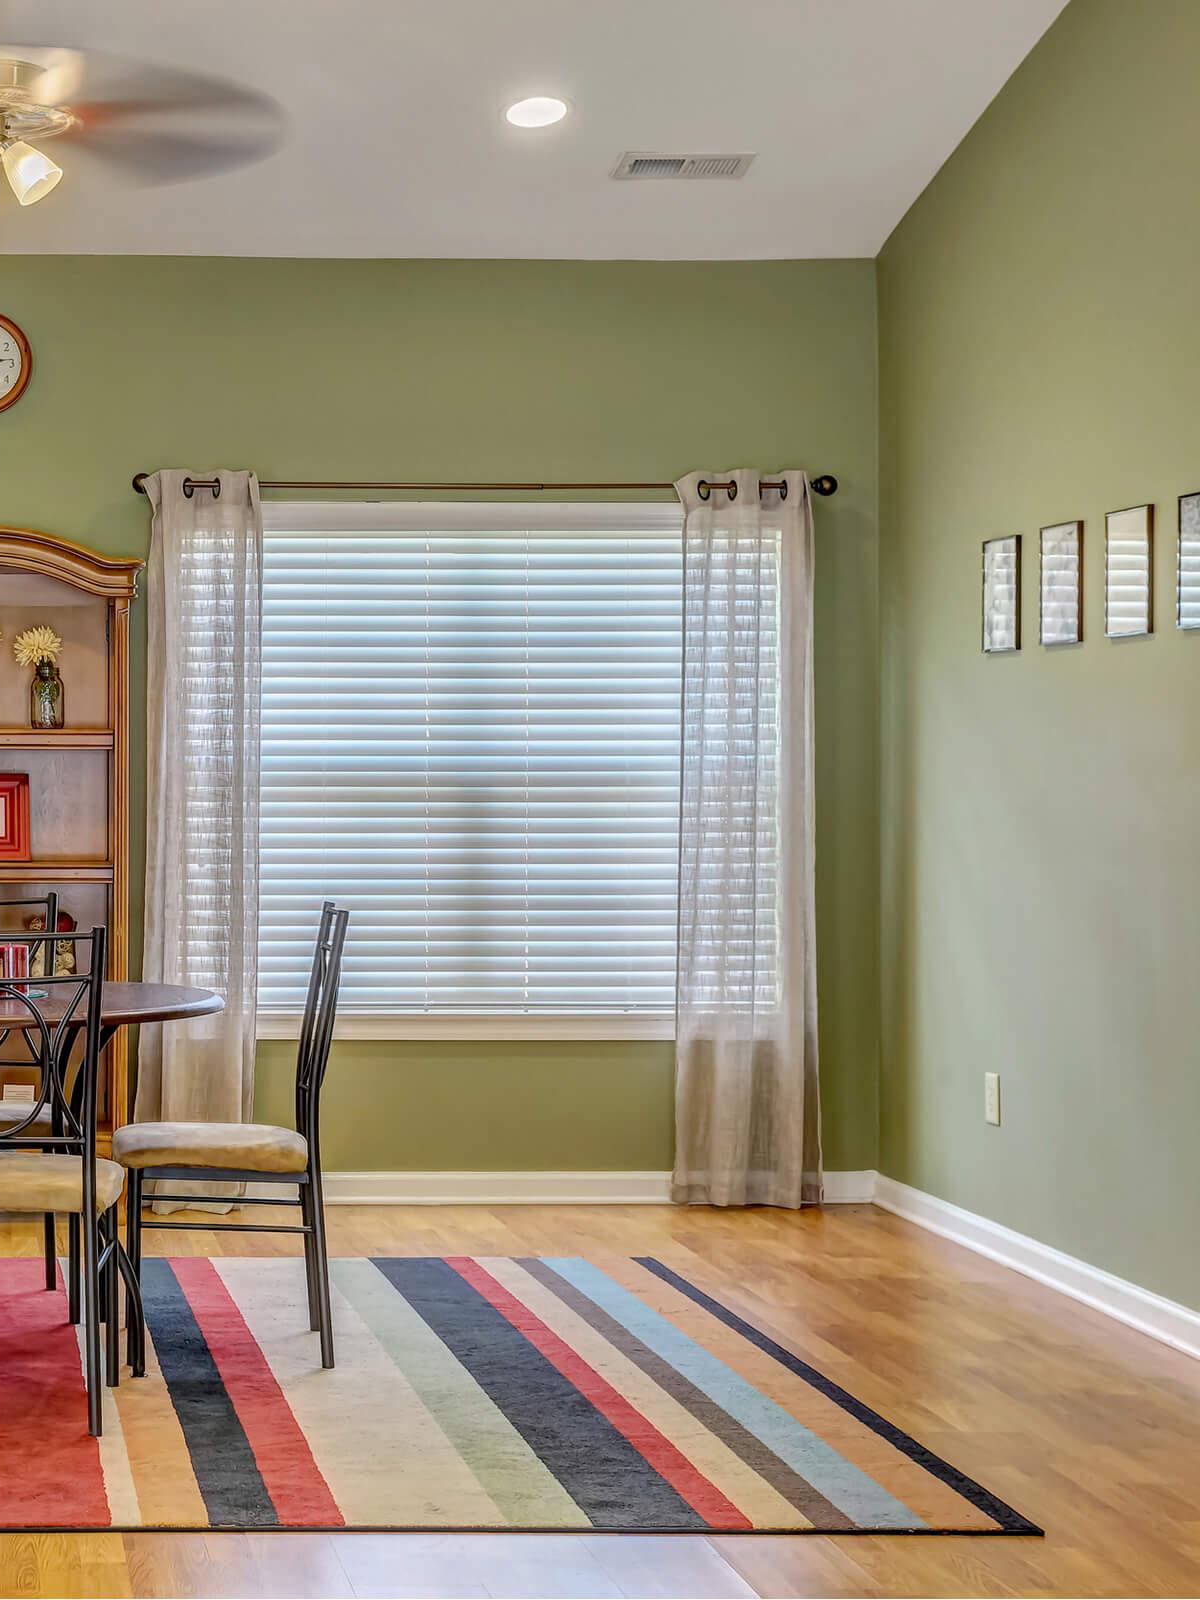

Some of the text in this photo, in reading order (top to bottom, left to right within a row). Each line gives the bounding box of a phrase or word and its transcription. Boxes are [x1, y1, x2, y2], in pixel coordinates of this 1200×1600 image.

[4, 343, 10, 352] 2
[9, 359, 15, 368] 3
[4, 375, 9, 384] 4
